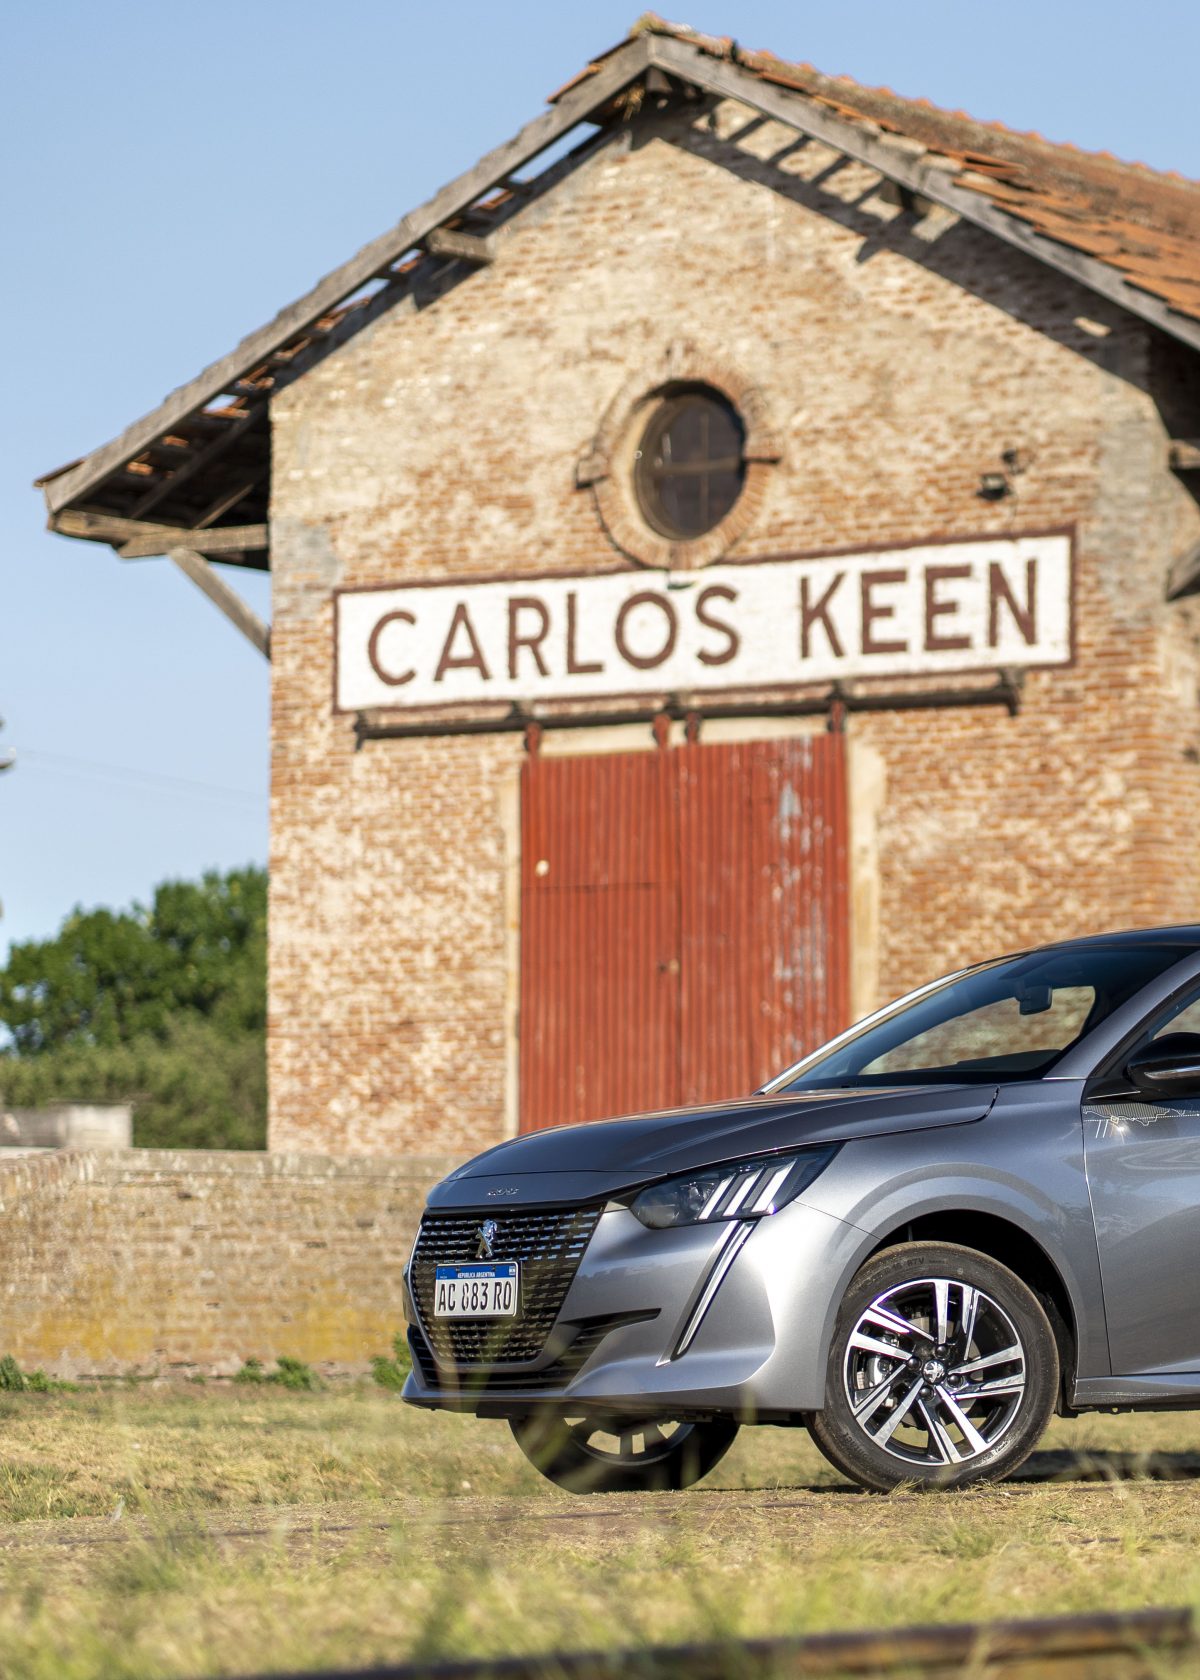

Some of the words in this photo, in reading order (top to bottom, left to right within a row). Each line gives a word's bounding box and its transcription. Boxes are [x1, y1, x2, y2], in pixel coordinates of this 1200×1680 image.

[367, 581, 742, 688] CARLOS
[798, 557, 1039, 661] KEEN
[438, 1283, 456, 1312] AC
